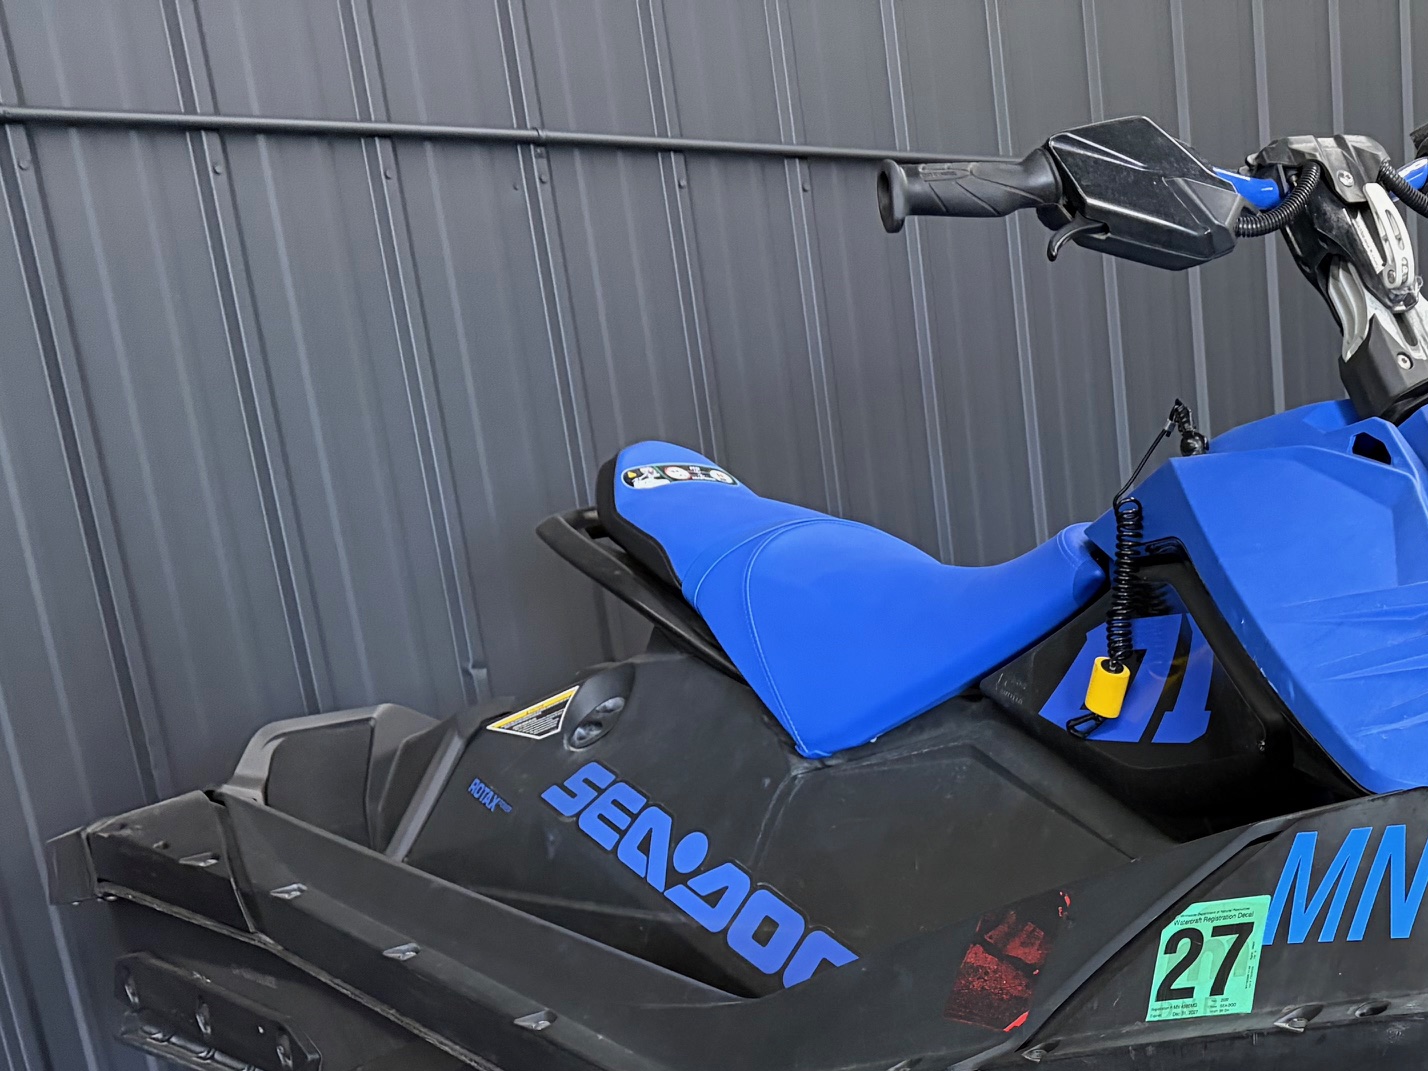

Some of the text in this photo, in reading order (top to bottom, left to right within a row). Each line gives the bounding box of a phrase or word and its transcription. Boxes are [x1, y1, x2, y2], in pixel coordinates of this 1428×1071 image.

[467, 777, 500, 812] ROTAX
[1203, 912, 1236, 924] Registration
[1237, 911, 1254, 919] Decal
[1155, 922, 1254, 1002] 27
